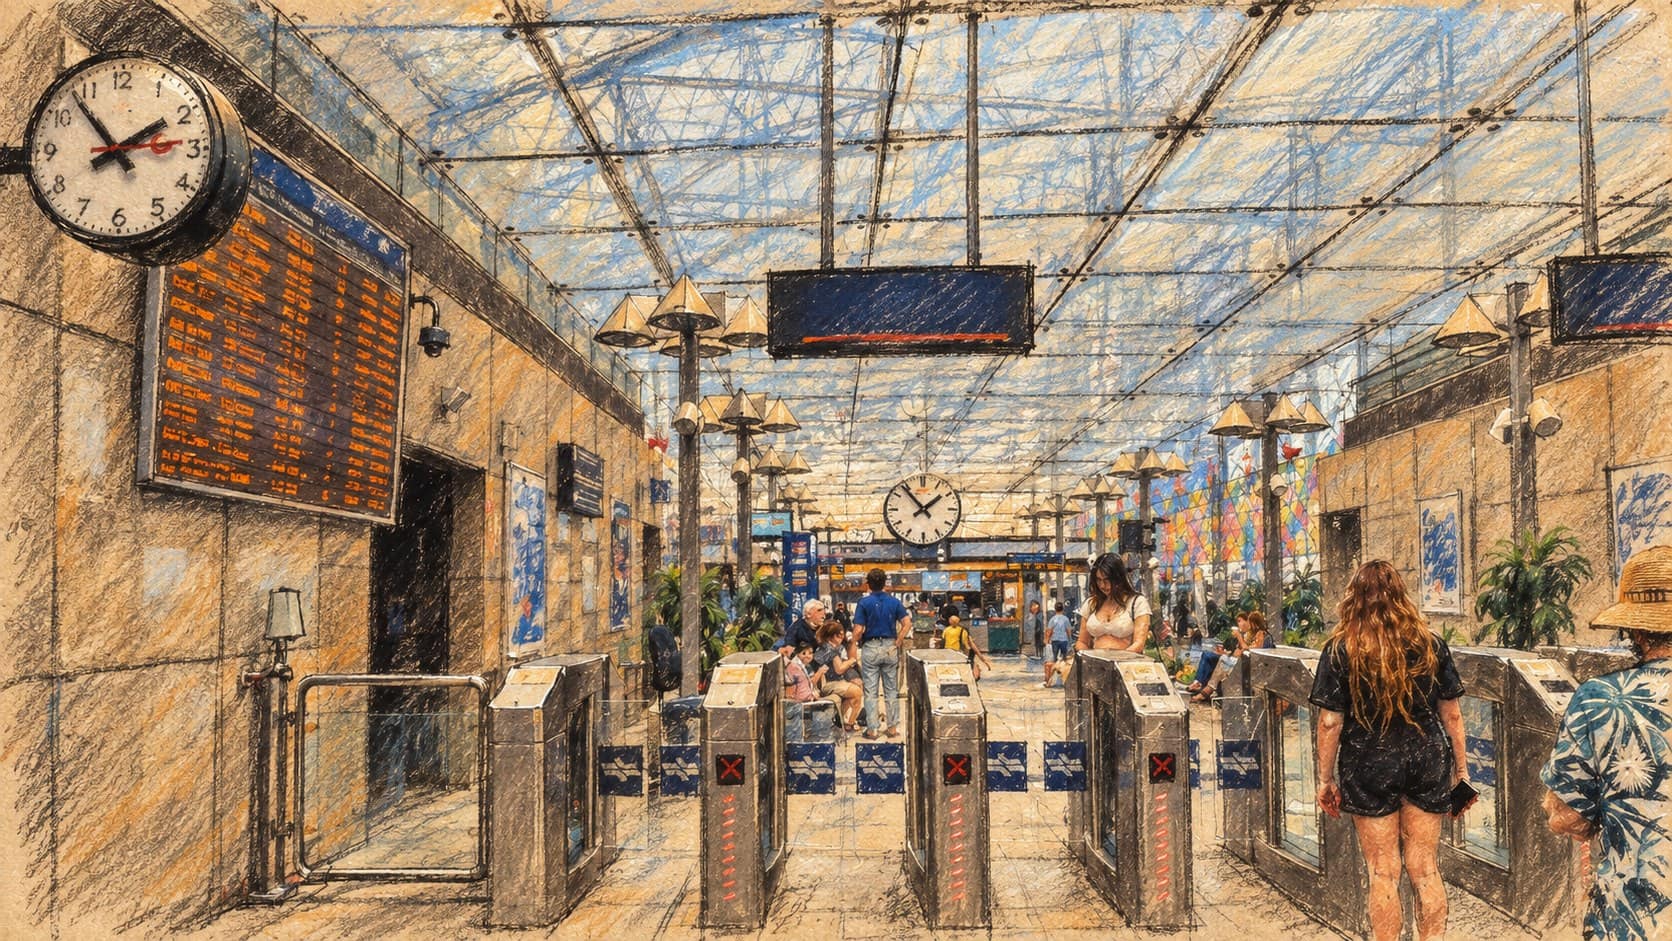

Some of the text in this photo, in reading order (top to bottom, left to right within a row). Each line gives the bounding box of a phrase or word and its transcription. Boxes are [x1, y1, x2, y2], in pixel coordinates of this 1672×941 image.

[113, 71, 132, 90] 12
[156, 81, 161, 97] 1
[82, 82, 97, 99] 11
[54, 108, 72, 128] 10
[176, 104, 191, 125] 2
[43, 143, 58, 161] 9
[186, 139, 201, 159] 3
[52, 174, 66, 194] 8
[175, 172, 190, 191] 4
[77, 197, 91, 217] 7
[150, 197, 165, 216] 5
[111, 207, 127, 228] 6
